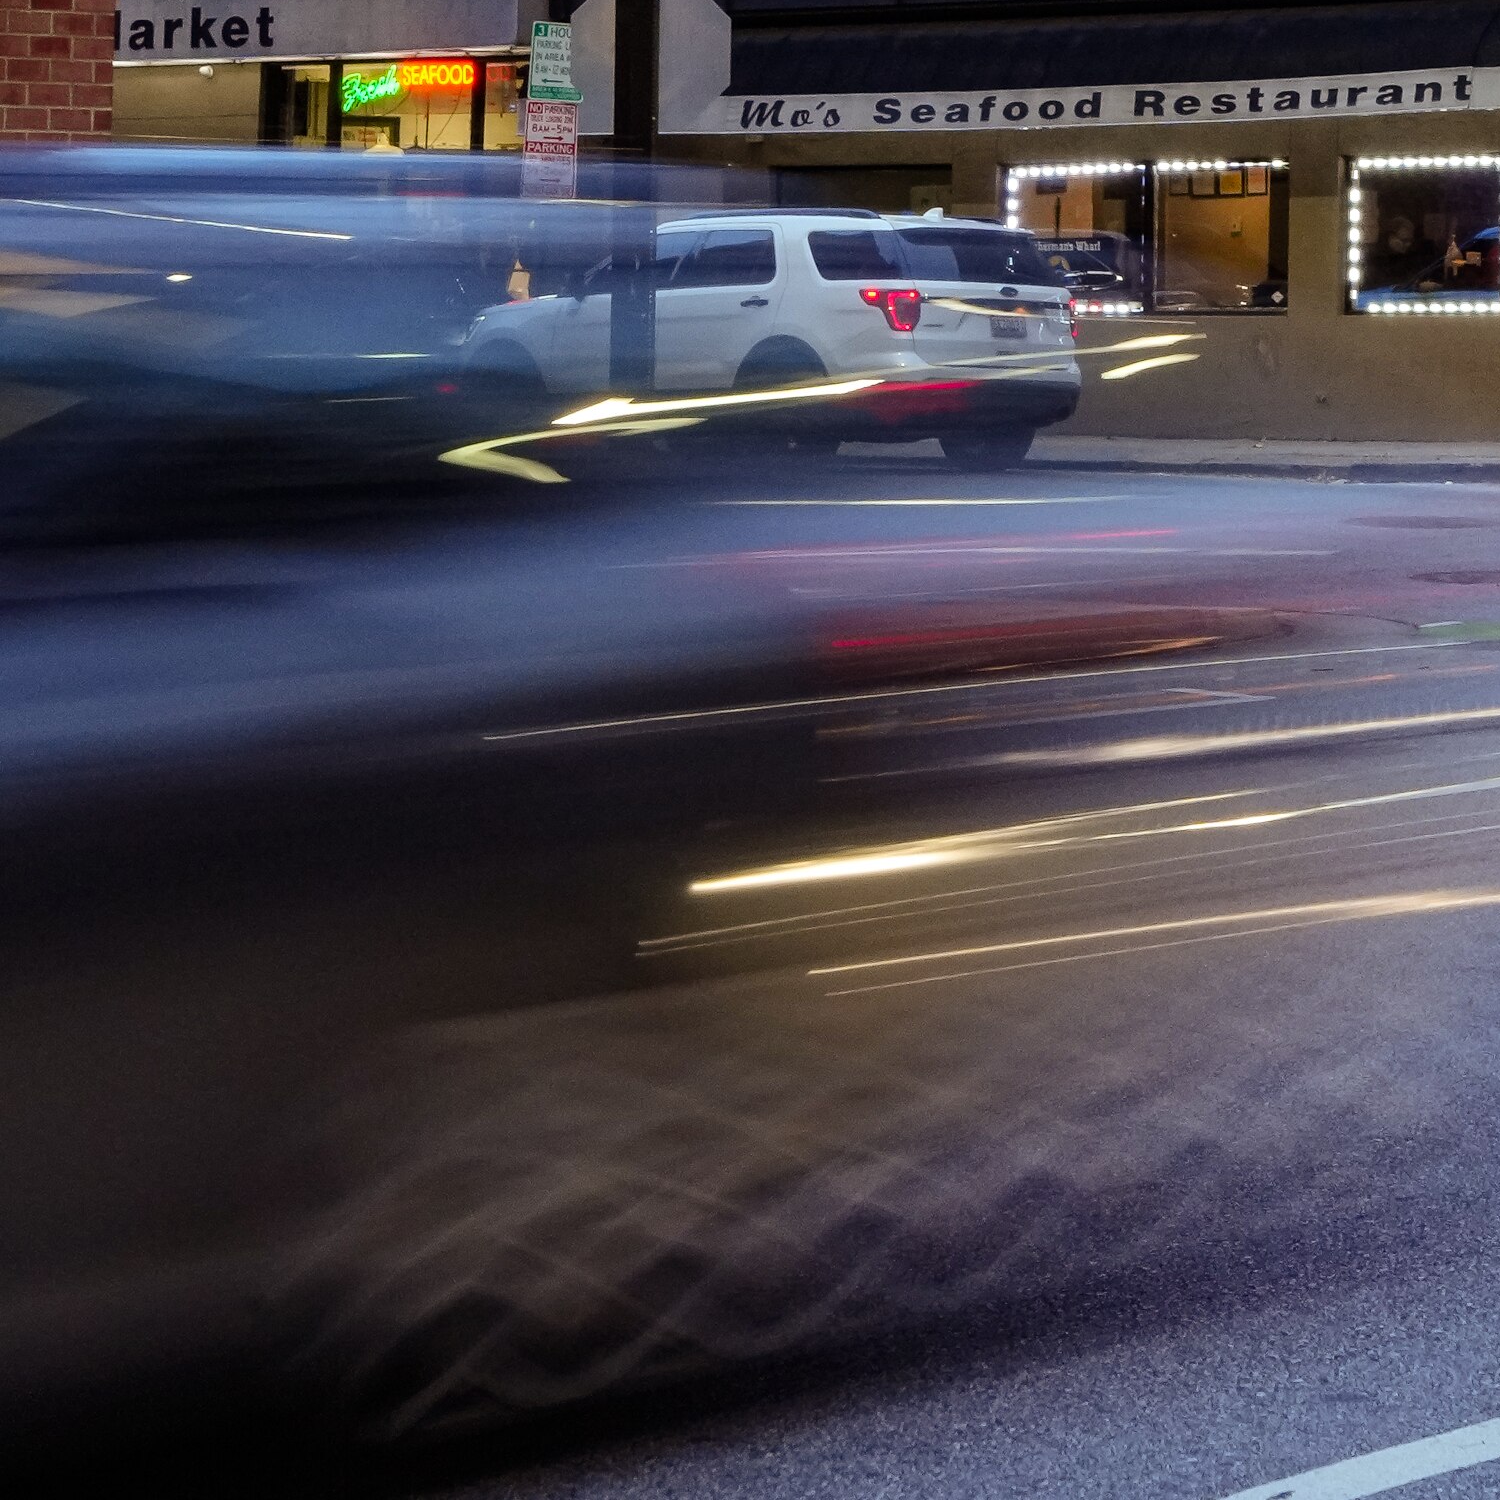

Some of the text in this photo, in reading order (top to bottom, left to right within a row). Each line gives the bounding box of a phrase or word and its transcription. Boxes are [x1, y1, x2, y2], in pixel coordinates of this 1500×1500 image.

[114, 7, 274, 51] arket
[537, 25, 572, 38] 3 HOU
[342, 64, 400, 112] Fresh
[402, 64, 474, 86] SEAFOOD
[740, 75, 1472, 129] Mo's Seafood Restaurant
[529, 103, 574, 115] NO PARKING
[527, 142, 574, 154] PARKING
